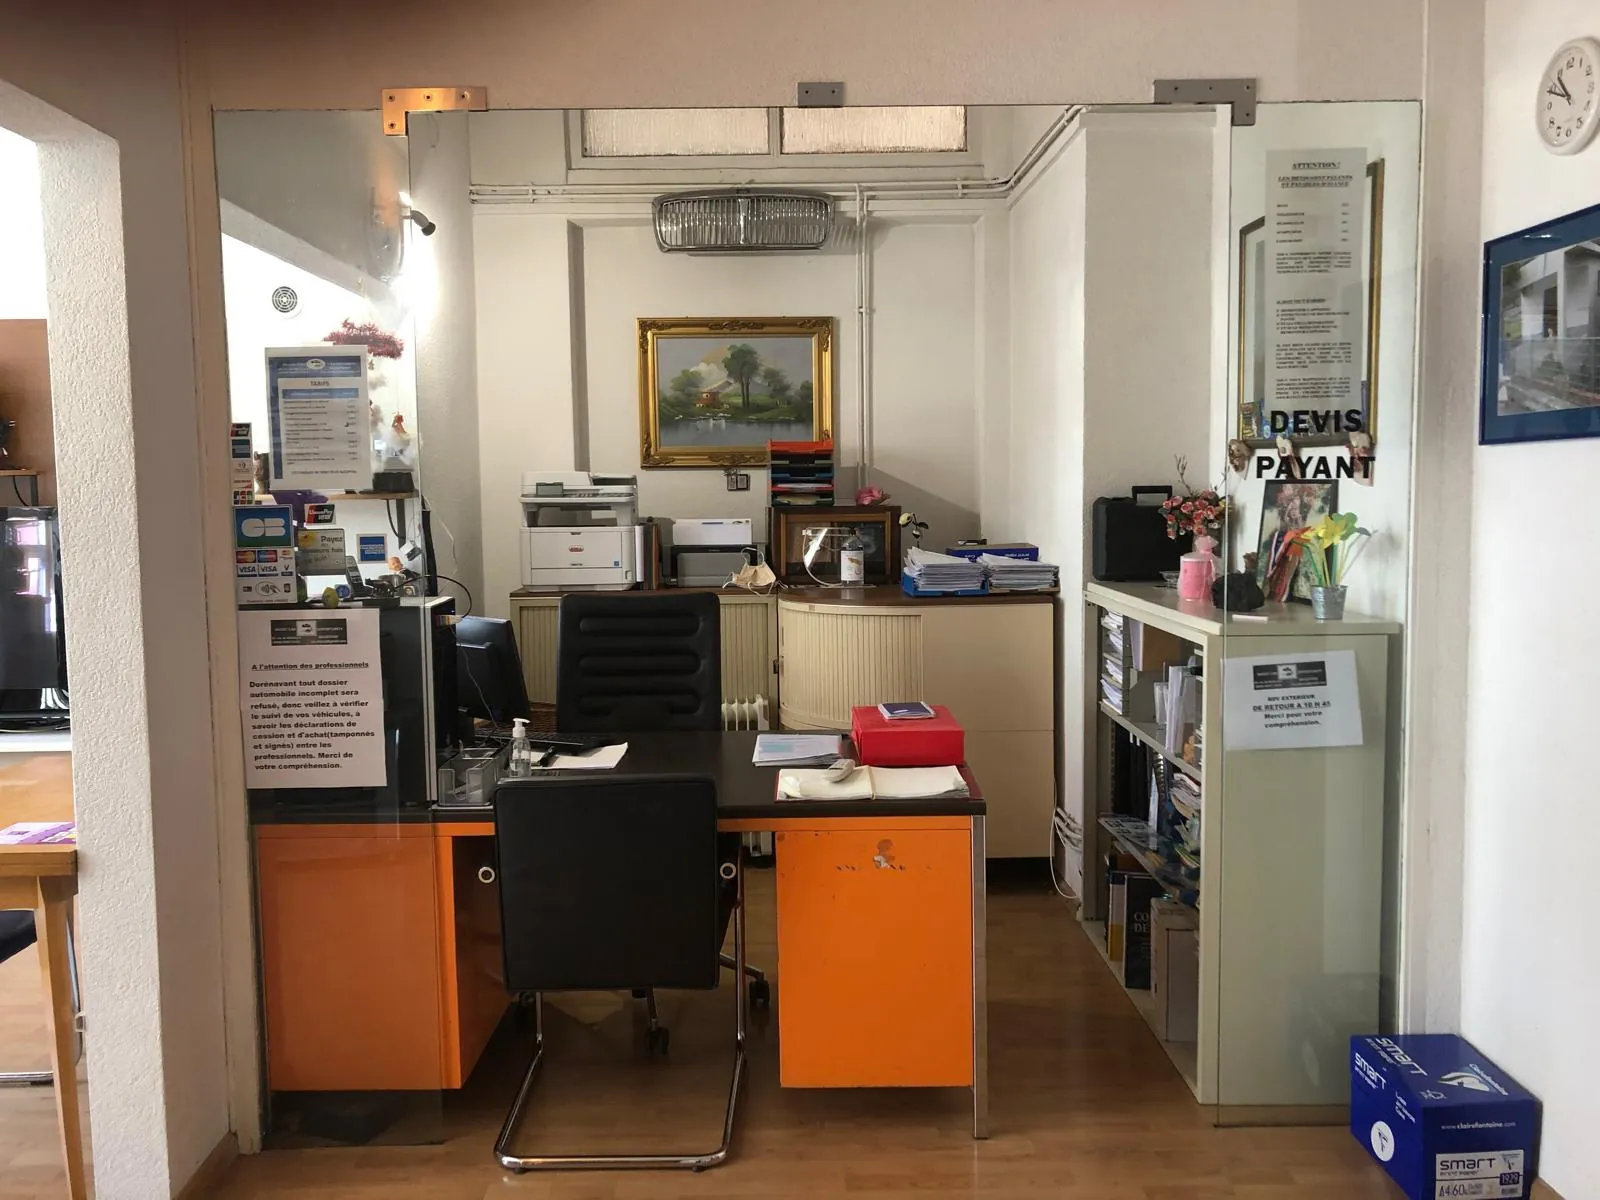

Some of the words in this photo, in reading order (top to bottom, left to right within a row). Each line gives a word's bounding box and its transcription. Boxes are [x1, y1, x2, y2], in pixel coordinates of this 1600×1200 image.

[1271, 409, 1362, 433] DEVIS
[1257, 456, 1376, 479] PAYANT
[315, 661, 369, 670] professionnels
[250, 690, 296, 698] automobile
[298, 689, 339, 697] incomplet
[253, 732, 284, 740] cession
[254, 752, 316, 761] professionnels.
[1376, 1038, 1428, 1076] smart
[1355, 1052, 1387, 1089] smart
[1440, 1158, 1496, 1170] smart
